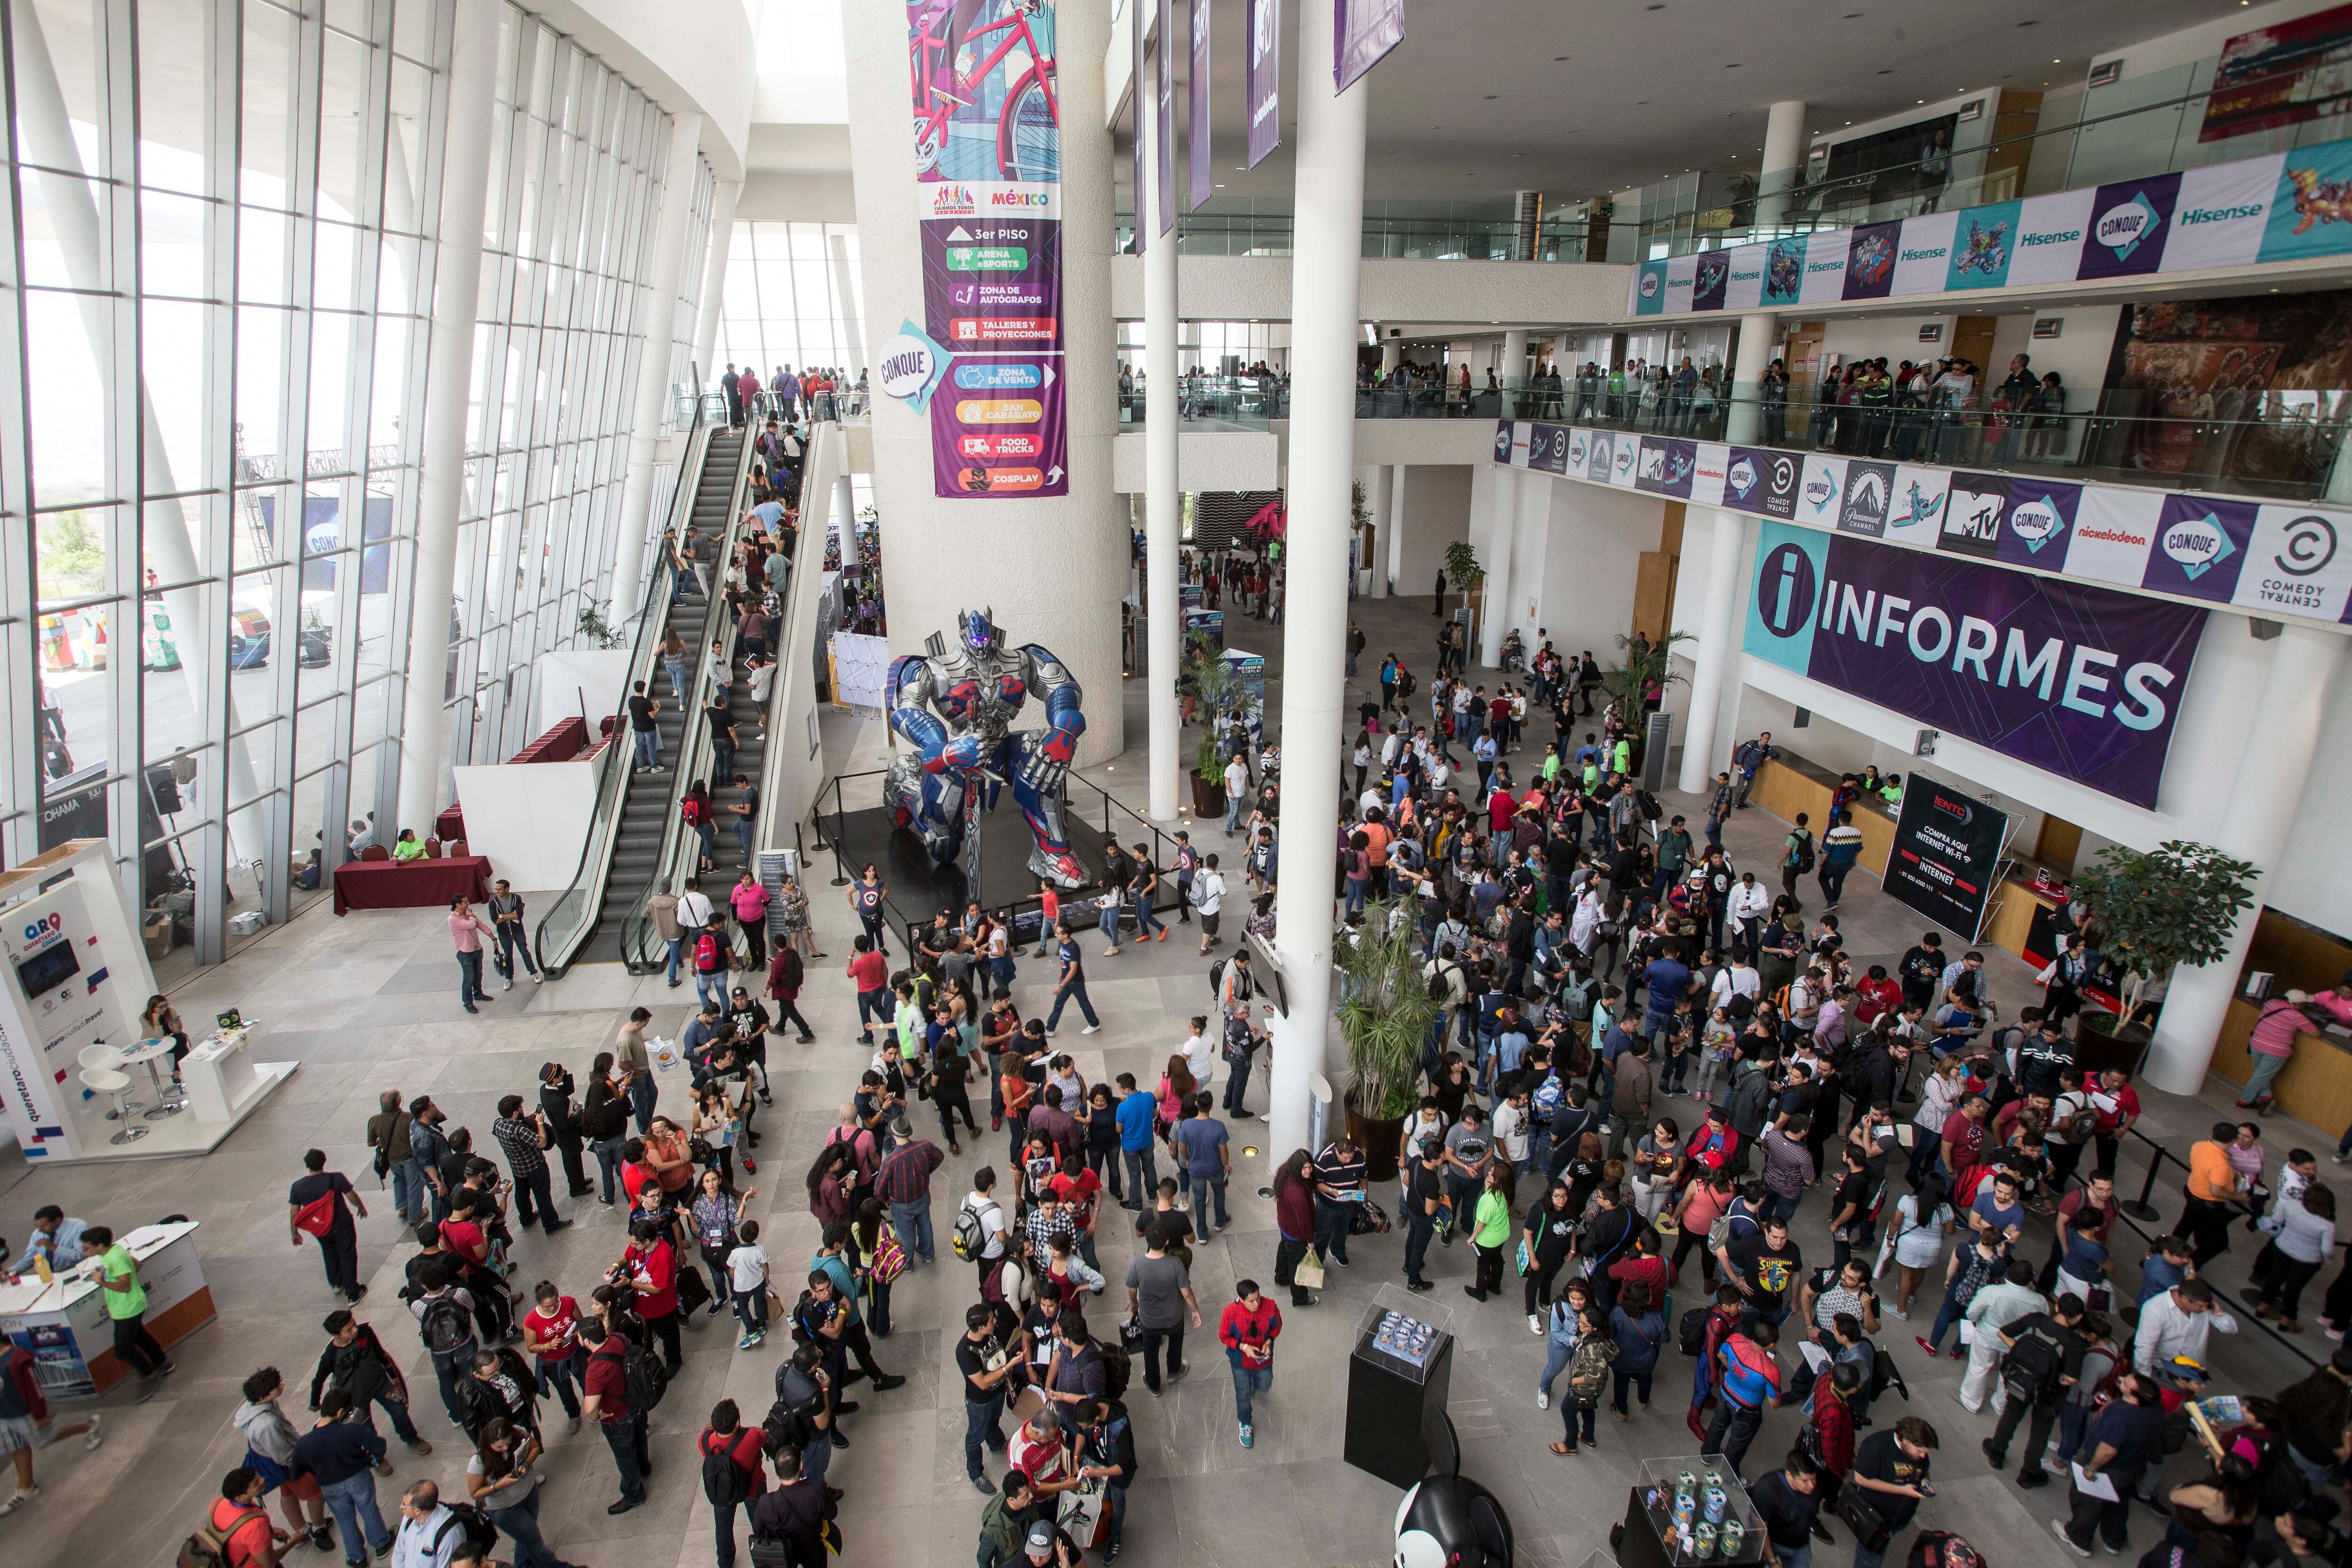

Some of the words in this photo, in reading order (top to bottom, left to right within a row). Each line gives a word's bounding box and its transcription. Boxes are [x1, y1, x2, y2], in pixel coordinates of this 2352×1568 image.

[1253, 90, 1277, 128] nickelodeo
[2180, 202, 2263, 226] Hisense
[2101, 215, 2145, 236] CONQUE
[975, 229, 995, 239] 3er
[998, 229, 1028, 240] PISO
[2020, 230, 2080, 247] Hisense
[1900, 246, 1947, 262] Hisense
[977, 259, 1019, 269] eSPORTS
[1808, 259, 1844, 273] Hisense
[1731, 270, 1760, 282] Hisense
[1641, 279, 1657, 292] CONQUE
[1668, 278, 1693, 288] Hisense
[979, 287, 1006, 295] ZONA
[1008, 287, 1020, 295] DE
[979, 293, 1042, 304] AUTÓGRAFOS
[983, 330, 1052, 339] PROYECCIONES
[881, 350, 925, 384] CONQUE
[998, 368, 1026, 376] ZONA
[988, 375, 1001, 384] DE
[1002, 375, 1036, 384] VENTA
[1002, 403, 1024, 412] SAN
[987, 410, 1040, 420] GARABATO
[1001, 438, 1028, 446] FOOD
[996, 445, 1034, 454] TRUCKS
[1571, 447, 1583, 456] CONQUE
[1617, 453, 1630, 463] CONQUE
[1638, 447, 1666, 481] MTV
[993, 474, 1039, 483] COSPLAY
[1696, 468, 1724, 480] nickelodeon
[1732, 470, 1752, 483] CONQUE
[1807, 482, 1829, 496] CONQUE
[1767, 496, 1790, 506] COMEDY
[1843, 508, 1882, 525] Paramount
[1943, 489, 2006, 541] MTV
[1849, 521, 1875, 531] CHANNEL
[2015, 515, 2051, 530] CONQUE
[2077, 525, 2146, 546] nickelodeon
[2168, 534, 2216, 554] CONQUE
[2262, 579, 2325, 597] COMEDY
[1820, 580, 2175, 732] INFORMES
[44, 798, 80, 822] OHAMA
[1934, 795, 1966, 818] IENTC
[1915, 830, 1945, 852] INTERNET
[1945, 845, 1962, 860] Wi-Fi
[1924, 826, 1950, 844] COMPRA
[1951, 839, 1969, 852] AQUÍ
[1919, 861, 1954, 886] INTERNET
[1915, 878, 1925, 887] 6000
[23, 930, 56, 951] QUERÉTARO
[41, 932, 63, 947] CIUDAD
[1759, 1259, 1792, 1270] SUPERMAN
